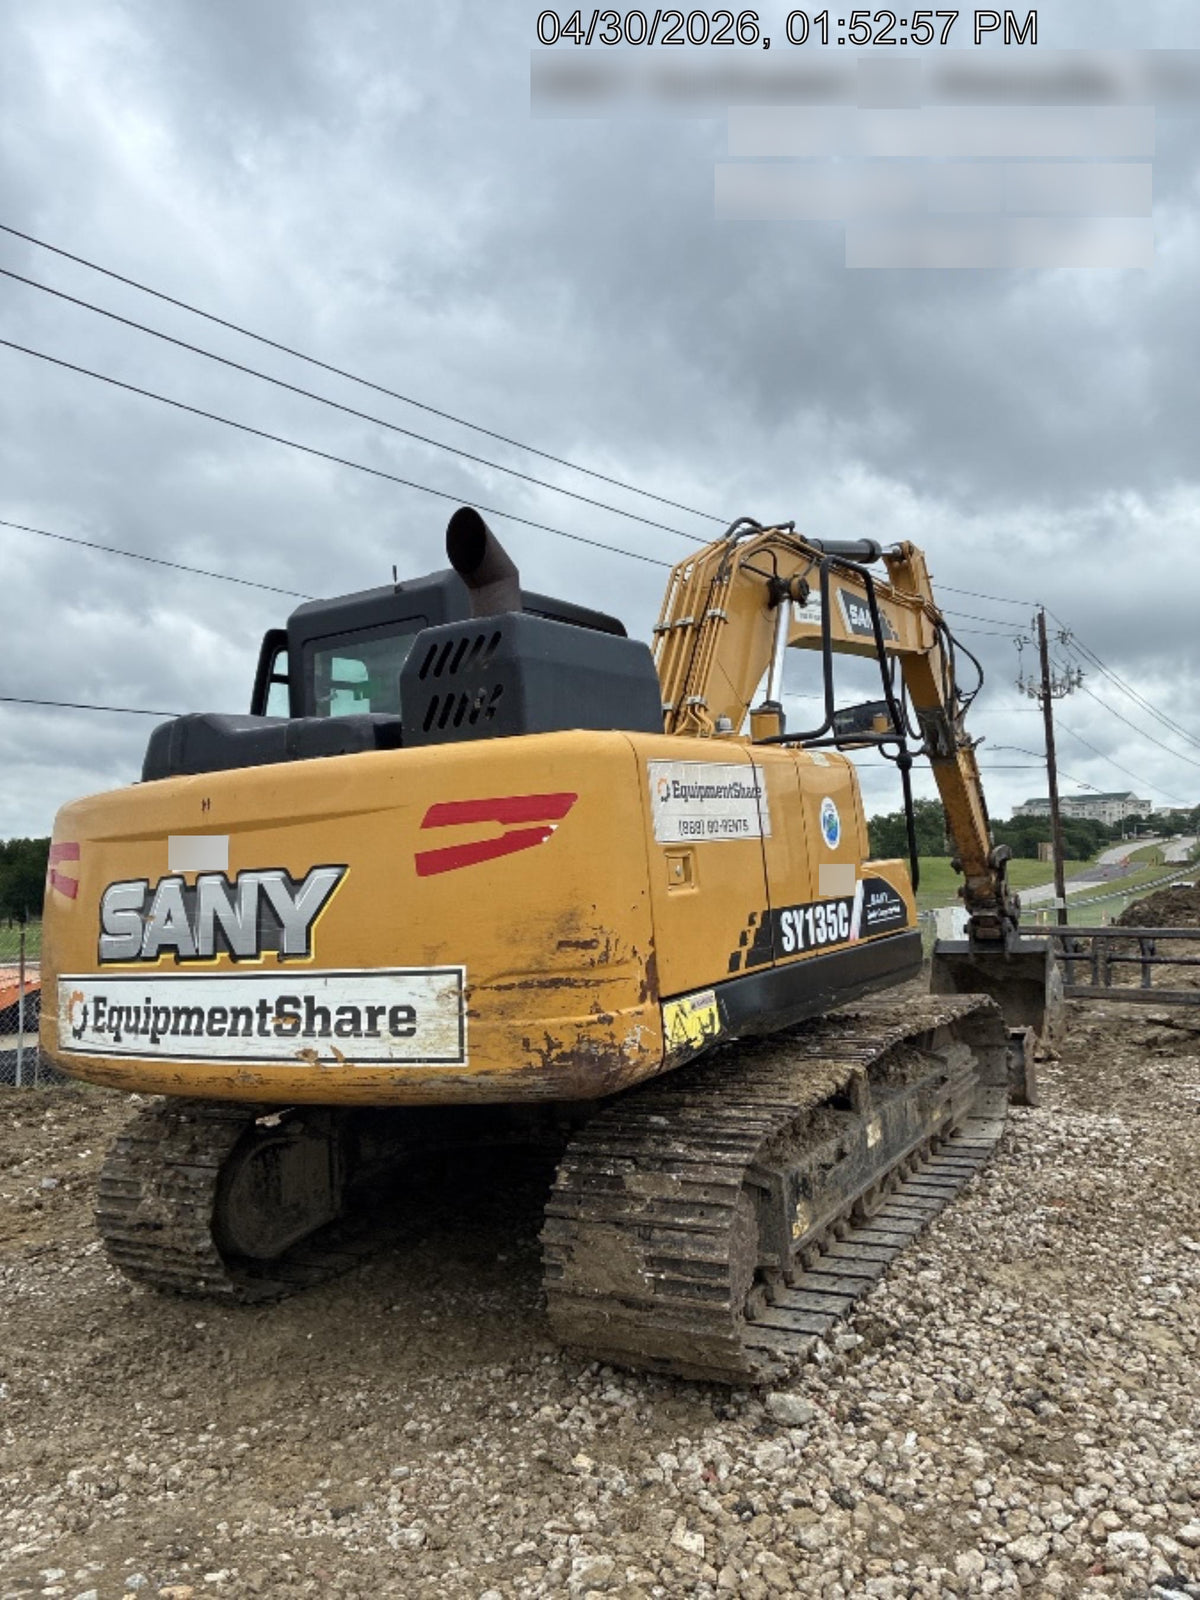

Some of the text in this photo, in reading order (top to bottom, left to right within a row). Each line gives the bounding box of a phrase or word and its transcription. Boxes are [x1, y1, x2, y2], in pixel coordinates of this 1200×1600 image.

[671, 780, 762, 802] EquipmentShare
[98, 865, 350, 966] SANY
[780, 901, 849, 952] SY135C
[92, 994, 417, 1045] EquipmentShare
